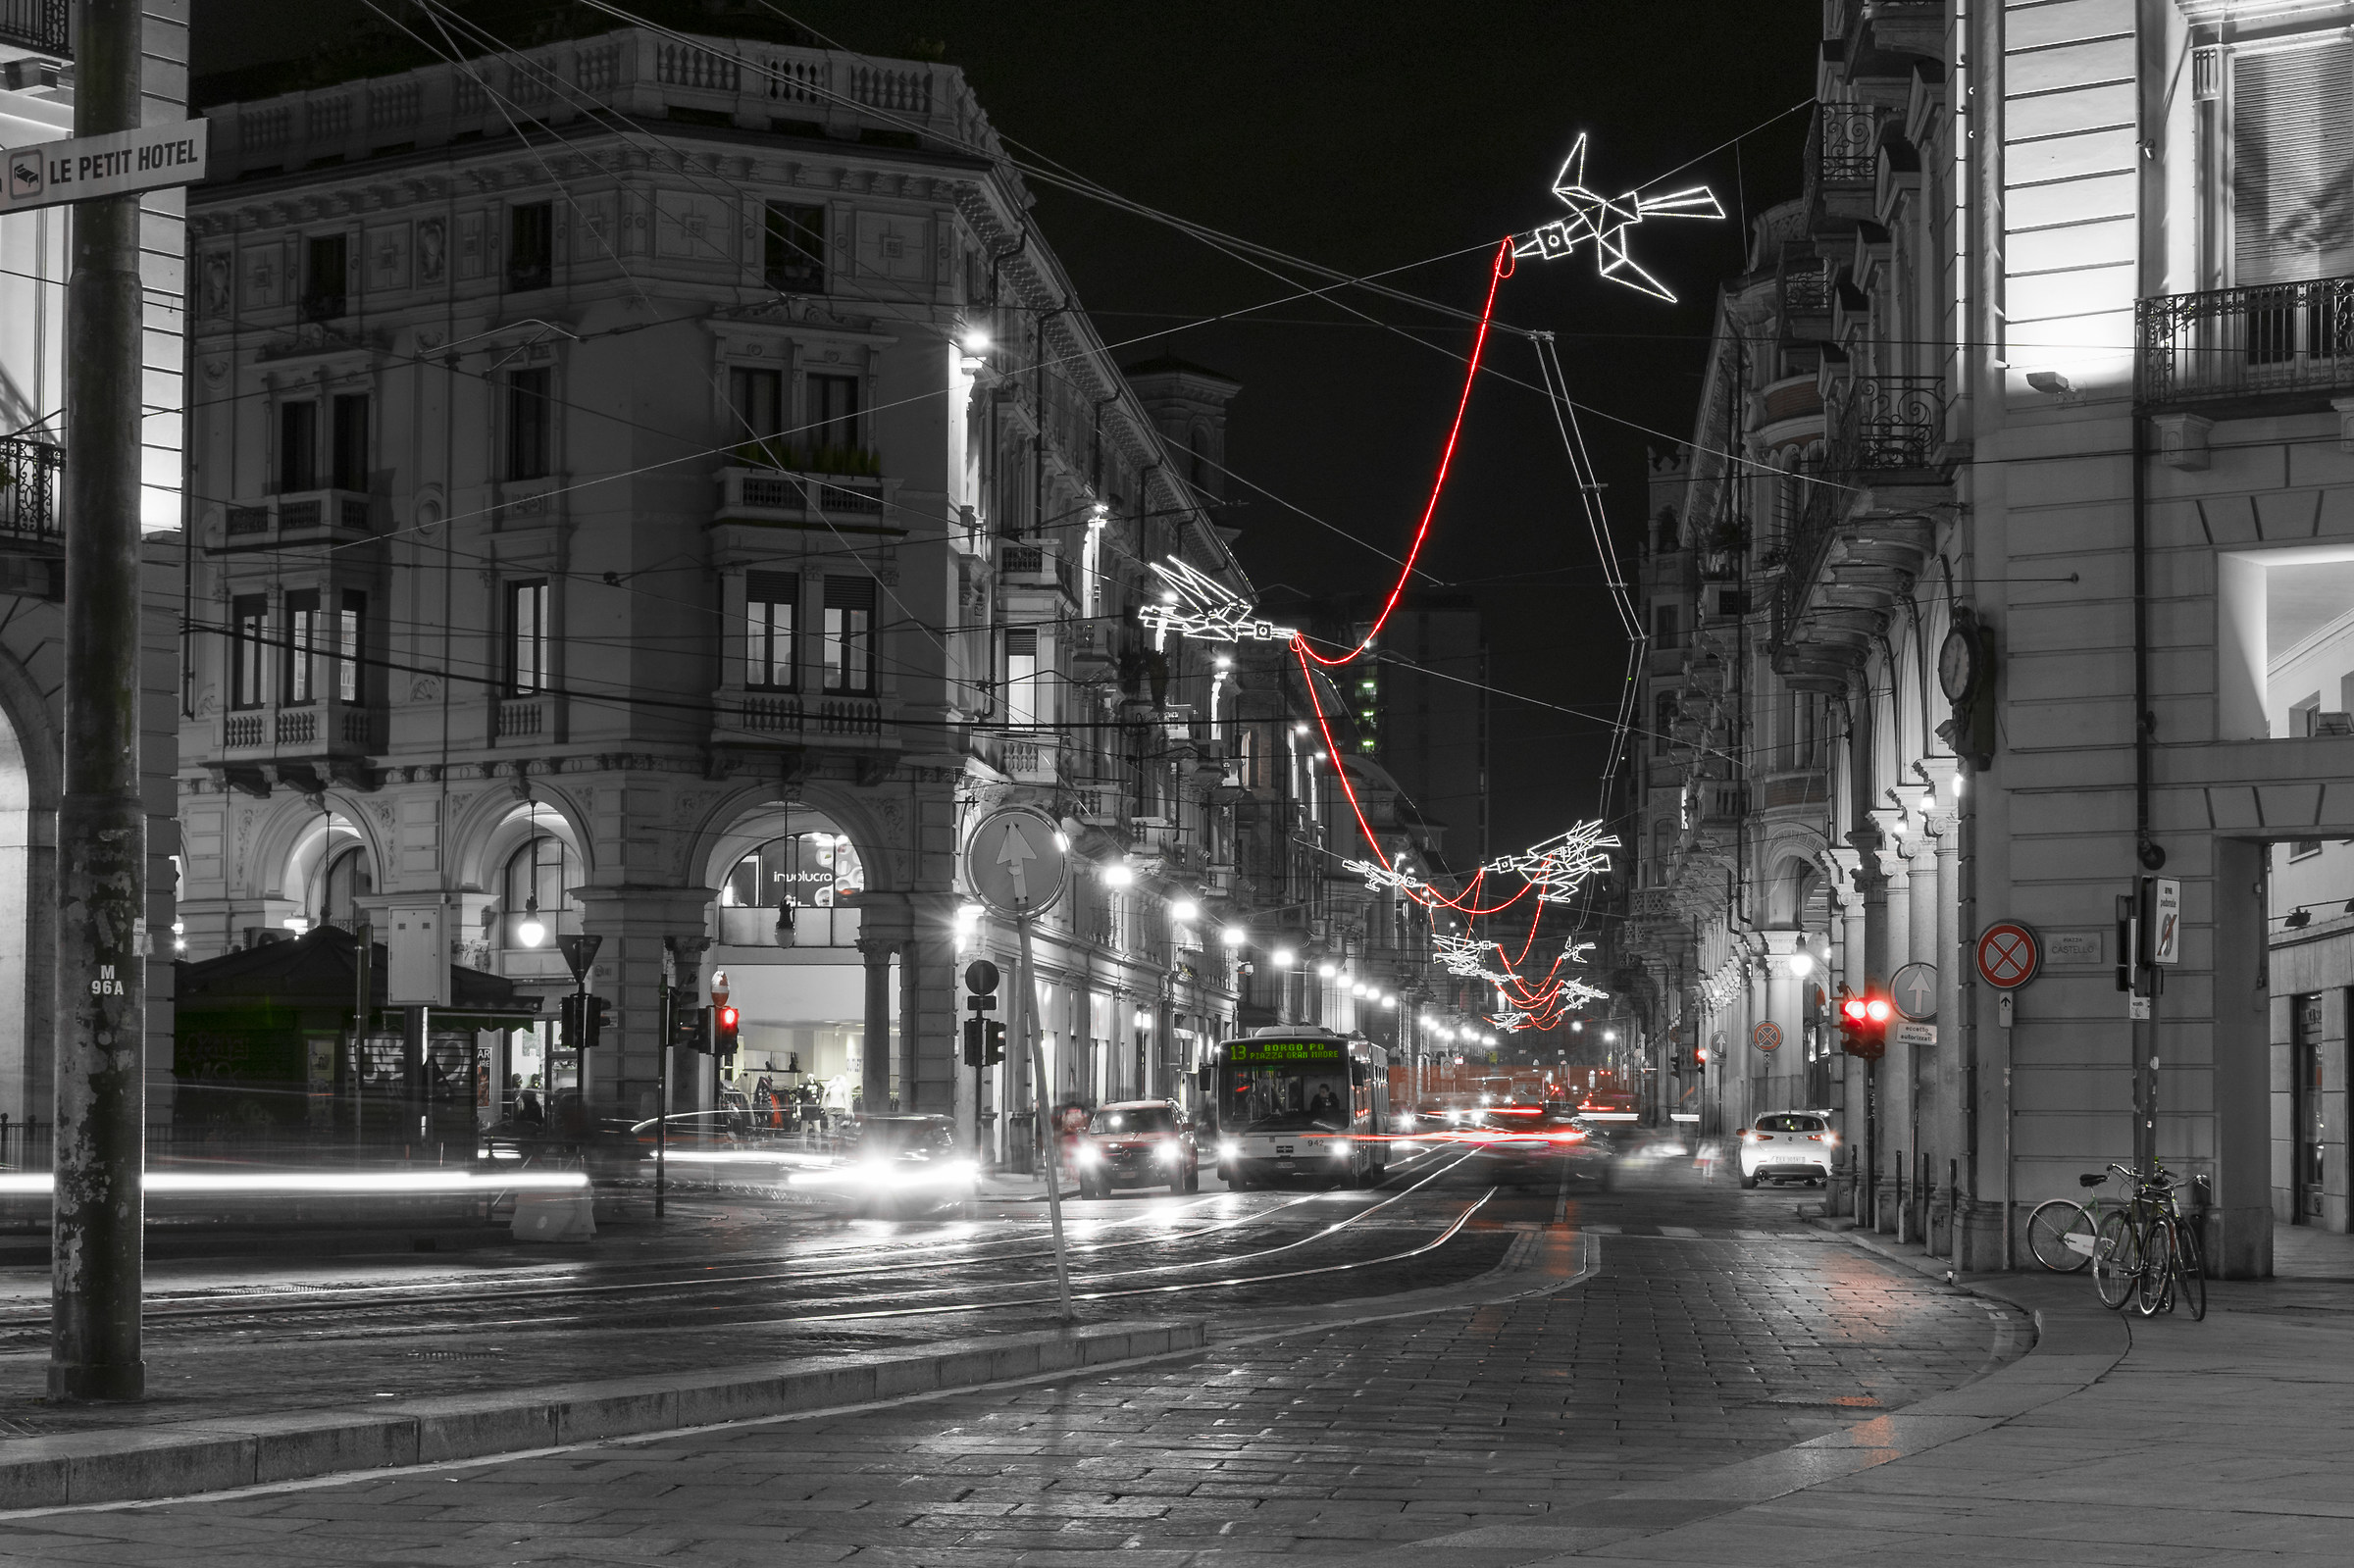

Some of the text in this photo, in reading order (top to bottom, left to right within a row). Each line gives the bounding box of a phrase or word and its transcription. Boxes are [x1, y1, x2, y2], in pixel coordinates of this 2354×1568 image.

[50, 139, 197, 185] LE PETIT HOTEL
[774, 871, 833, 883] involucra
[2051, 945, 2095, 954] CASTELLO
[101, 965, 115, 980] M
[91, 980, 125, 995] 96A
[1231, 1045, 1247, 1060] 13
[1264, 1043, 1304, 1052] BORGO
